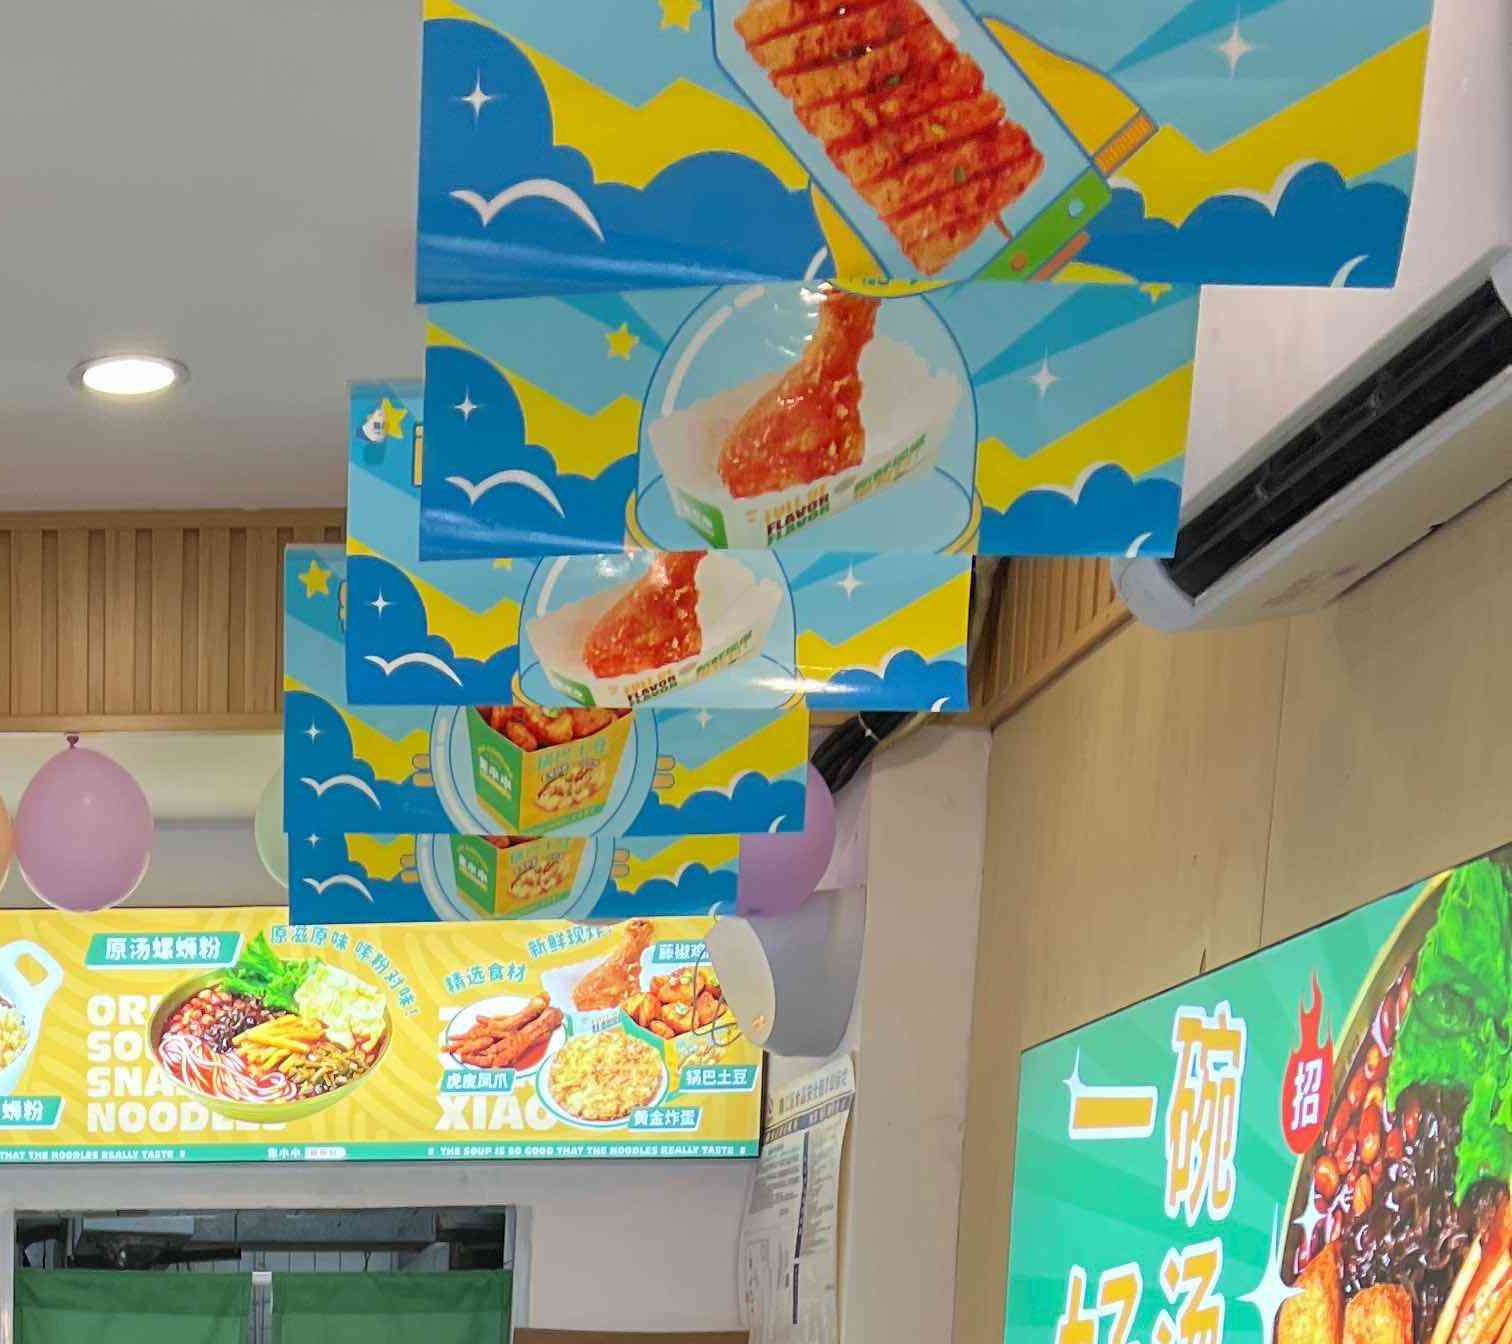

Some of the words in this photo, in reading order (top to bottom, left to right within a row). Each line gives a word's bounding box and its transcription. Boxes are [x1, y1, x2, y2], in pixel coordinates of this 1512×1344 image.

[767, 493, 830, 534] FLAVOR
[106, 936, 221, 960] 原汤螺蛳粉
[445, 962, 526, 993] 精选食材
[685, 1069, 750, 1087] 锅巴土豆
[1291, 1052, 1323, 1131] 招
[633, 1111, 696, 1127] 黄金炸蛋
[1068, 1001, 1248, 1227] 一碗
